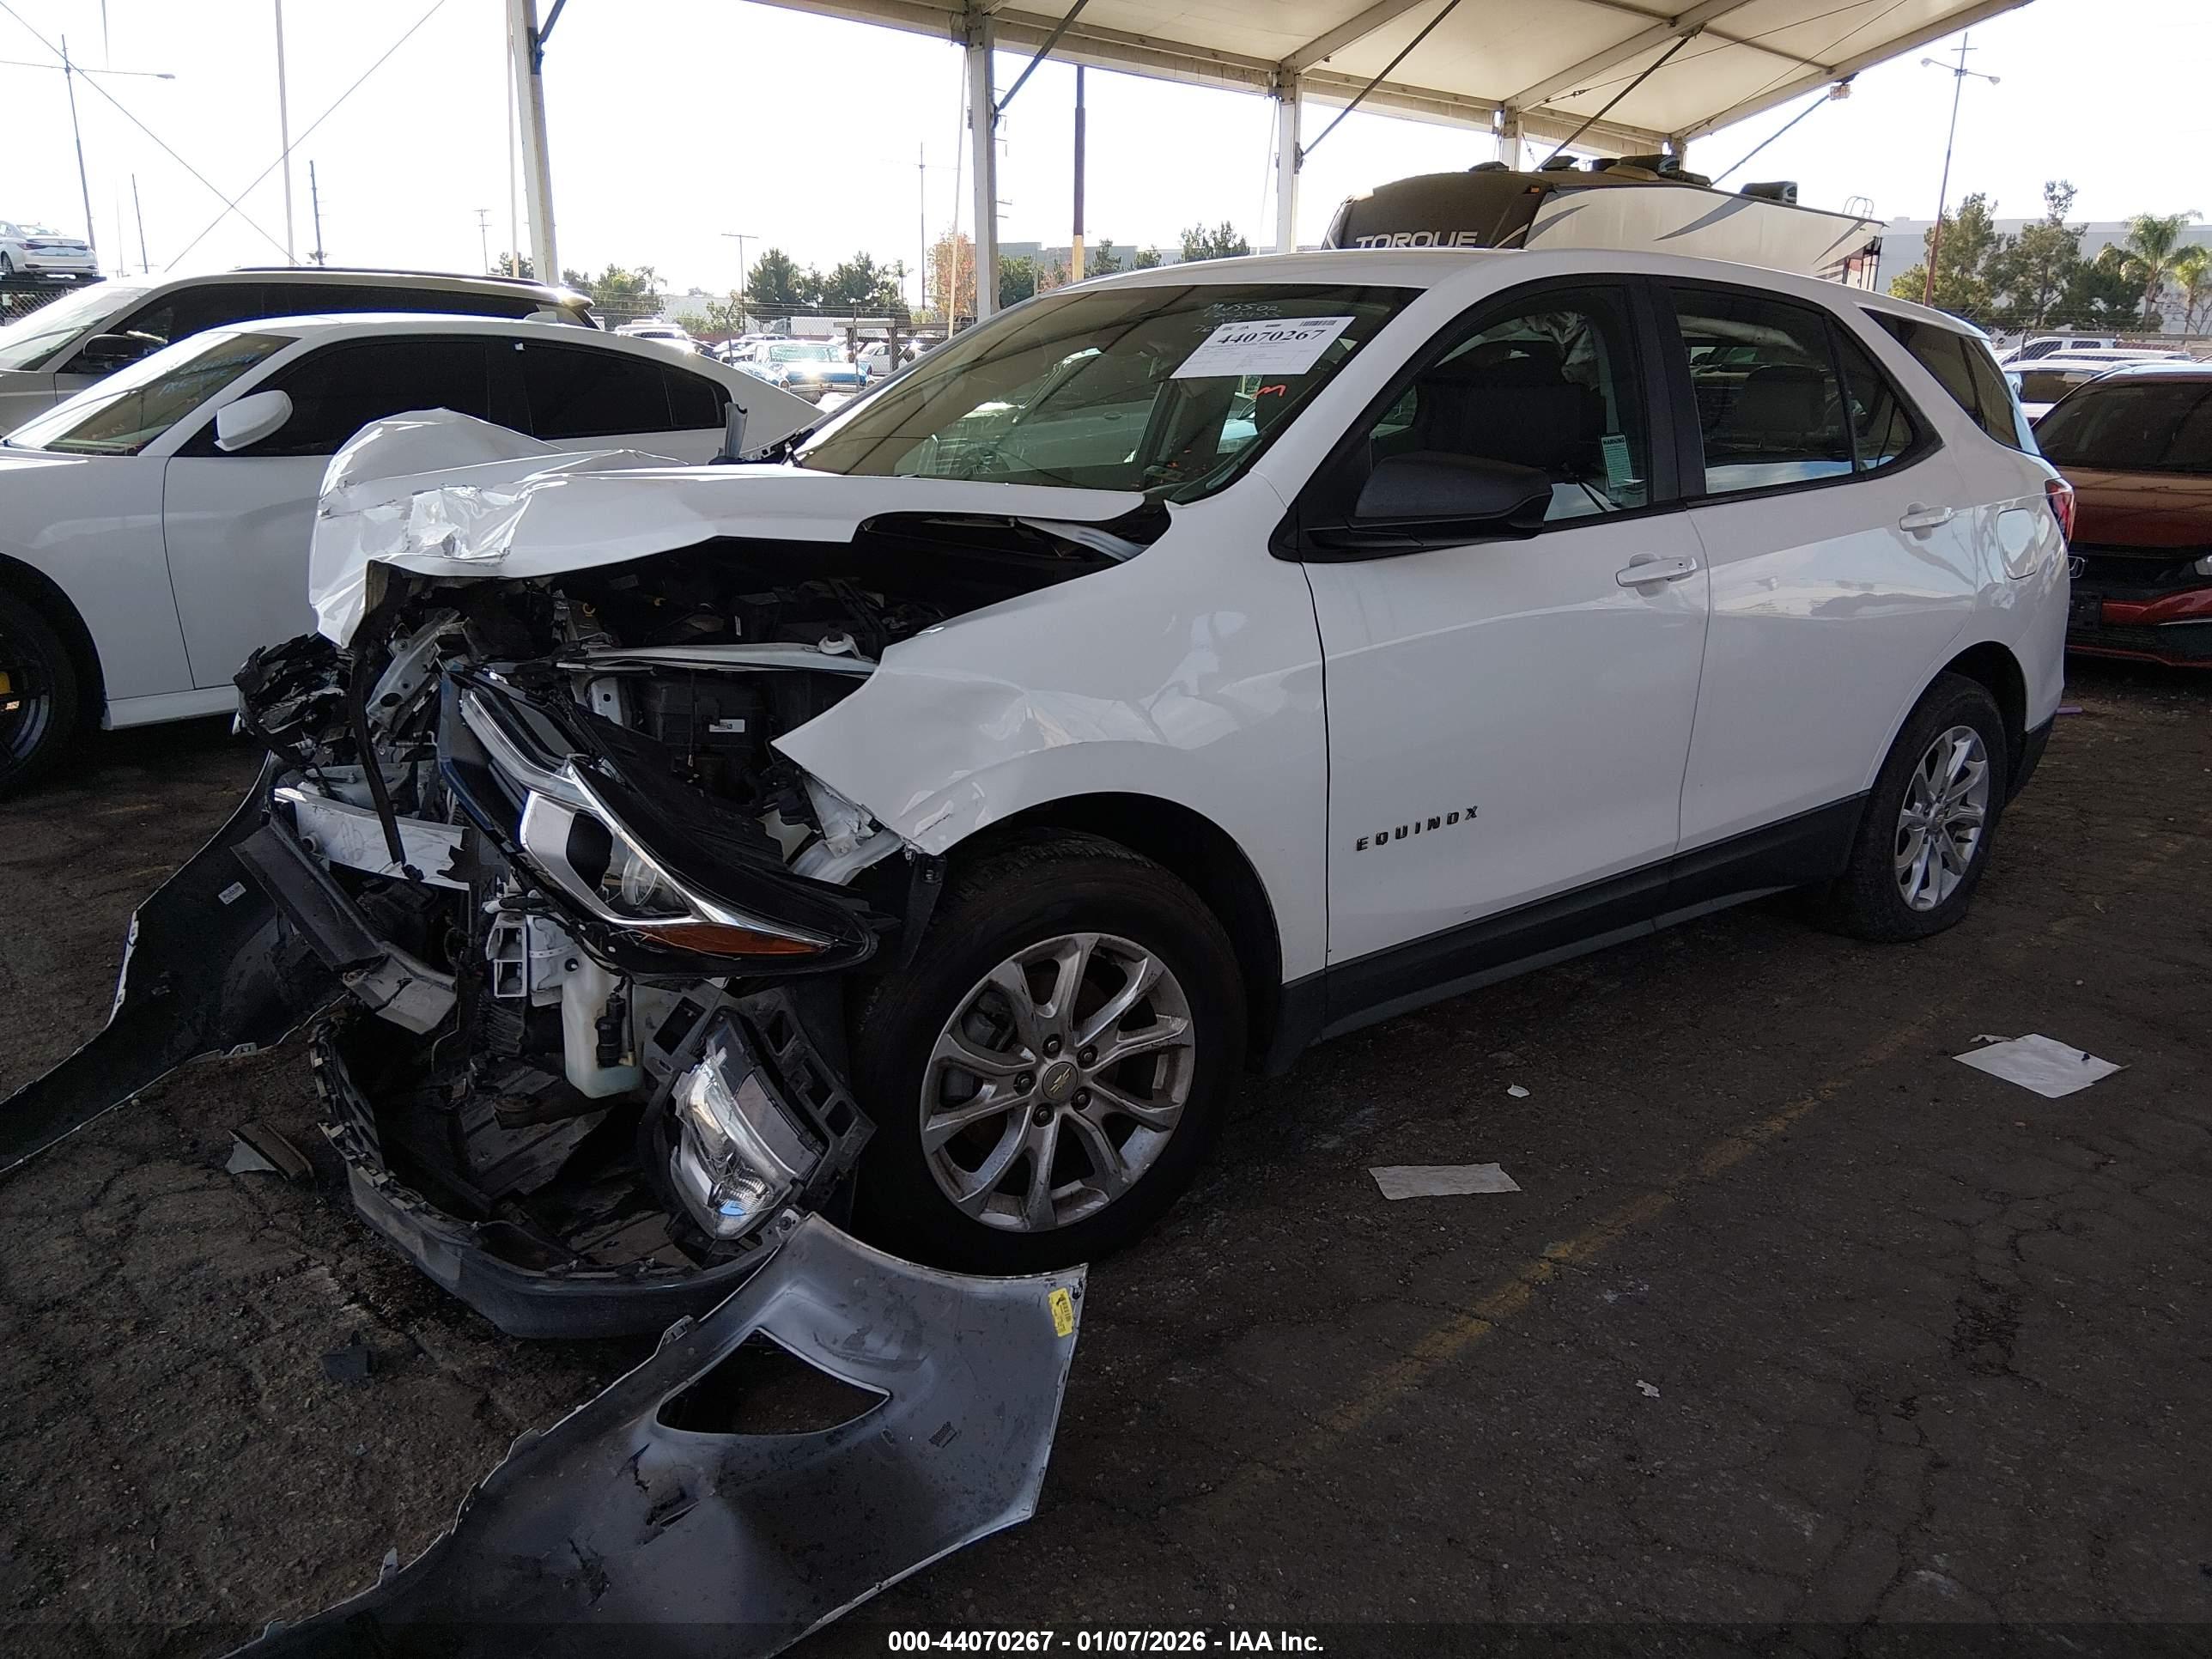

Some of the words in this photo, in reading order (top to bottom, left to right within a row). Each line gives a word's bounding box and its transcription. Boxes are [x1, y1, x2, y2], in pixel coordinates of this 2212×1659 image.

[1356, 231, 1479, 248] TORQUE
[1217, 330, 1327, 344] 44070267
[1602, 436, 1626, 445] WARNING
[1356, 805, 1479, 852] EQUINOX
